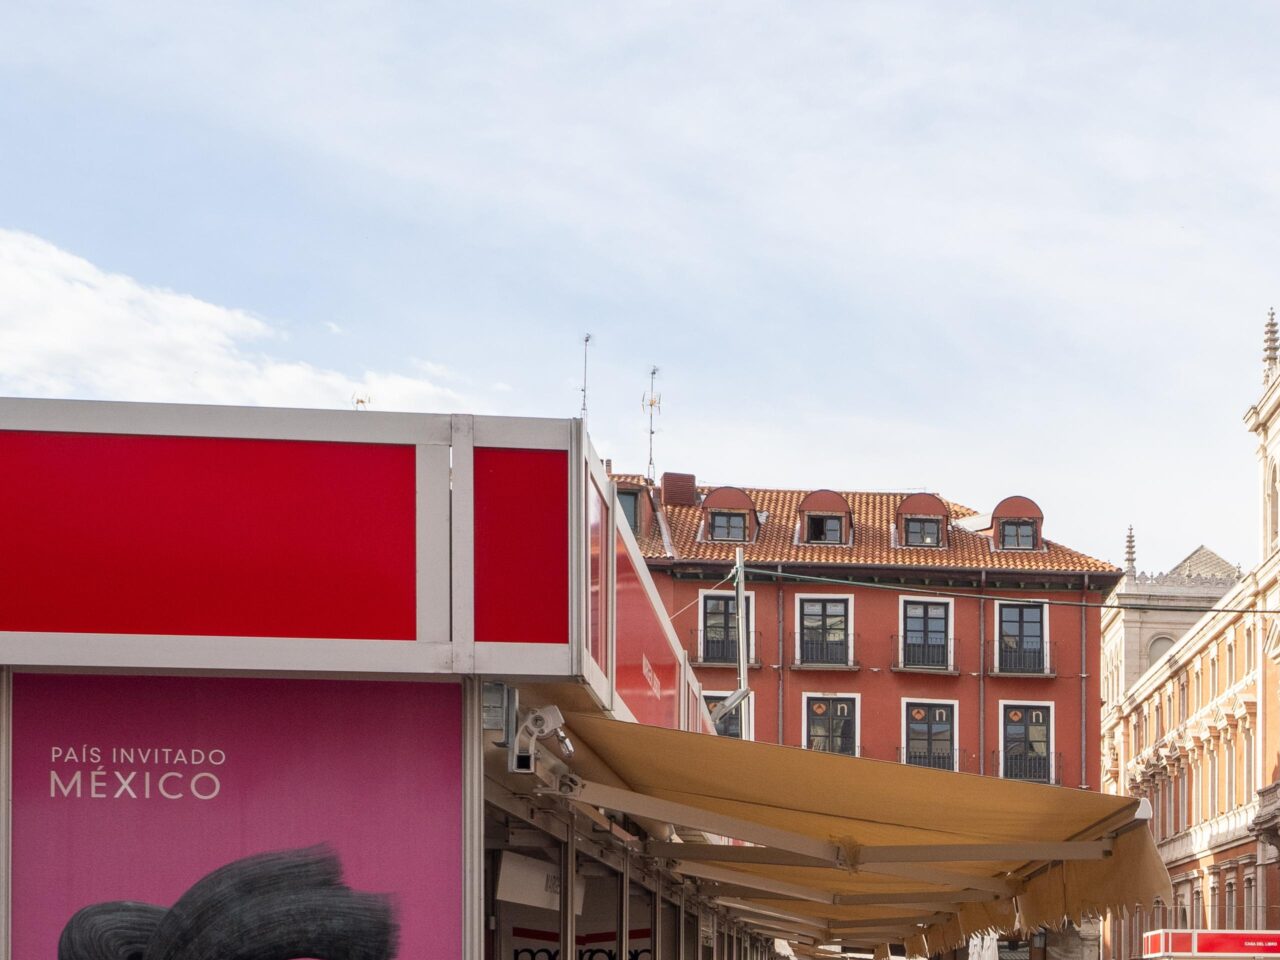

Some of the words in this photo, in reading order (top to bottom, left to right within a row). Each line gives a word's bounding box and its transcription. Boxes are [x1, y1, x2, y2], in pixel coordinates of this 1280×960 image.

[51, 744, 102, 763] PAÍS
[112, 747, 226, 765] INVITADO
[50, 767, 221, 800] MÉXICO
